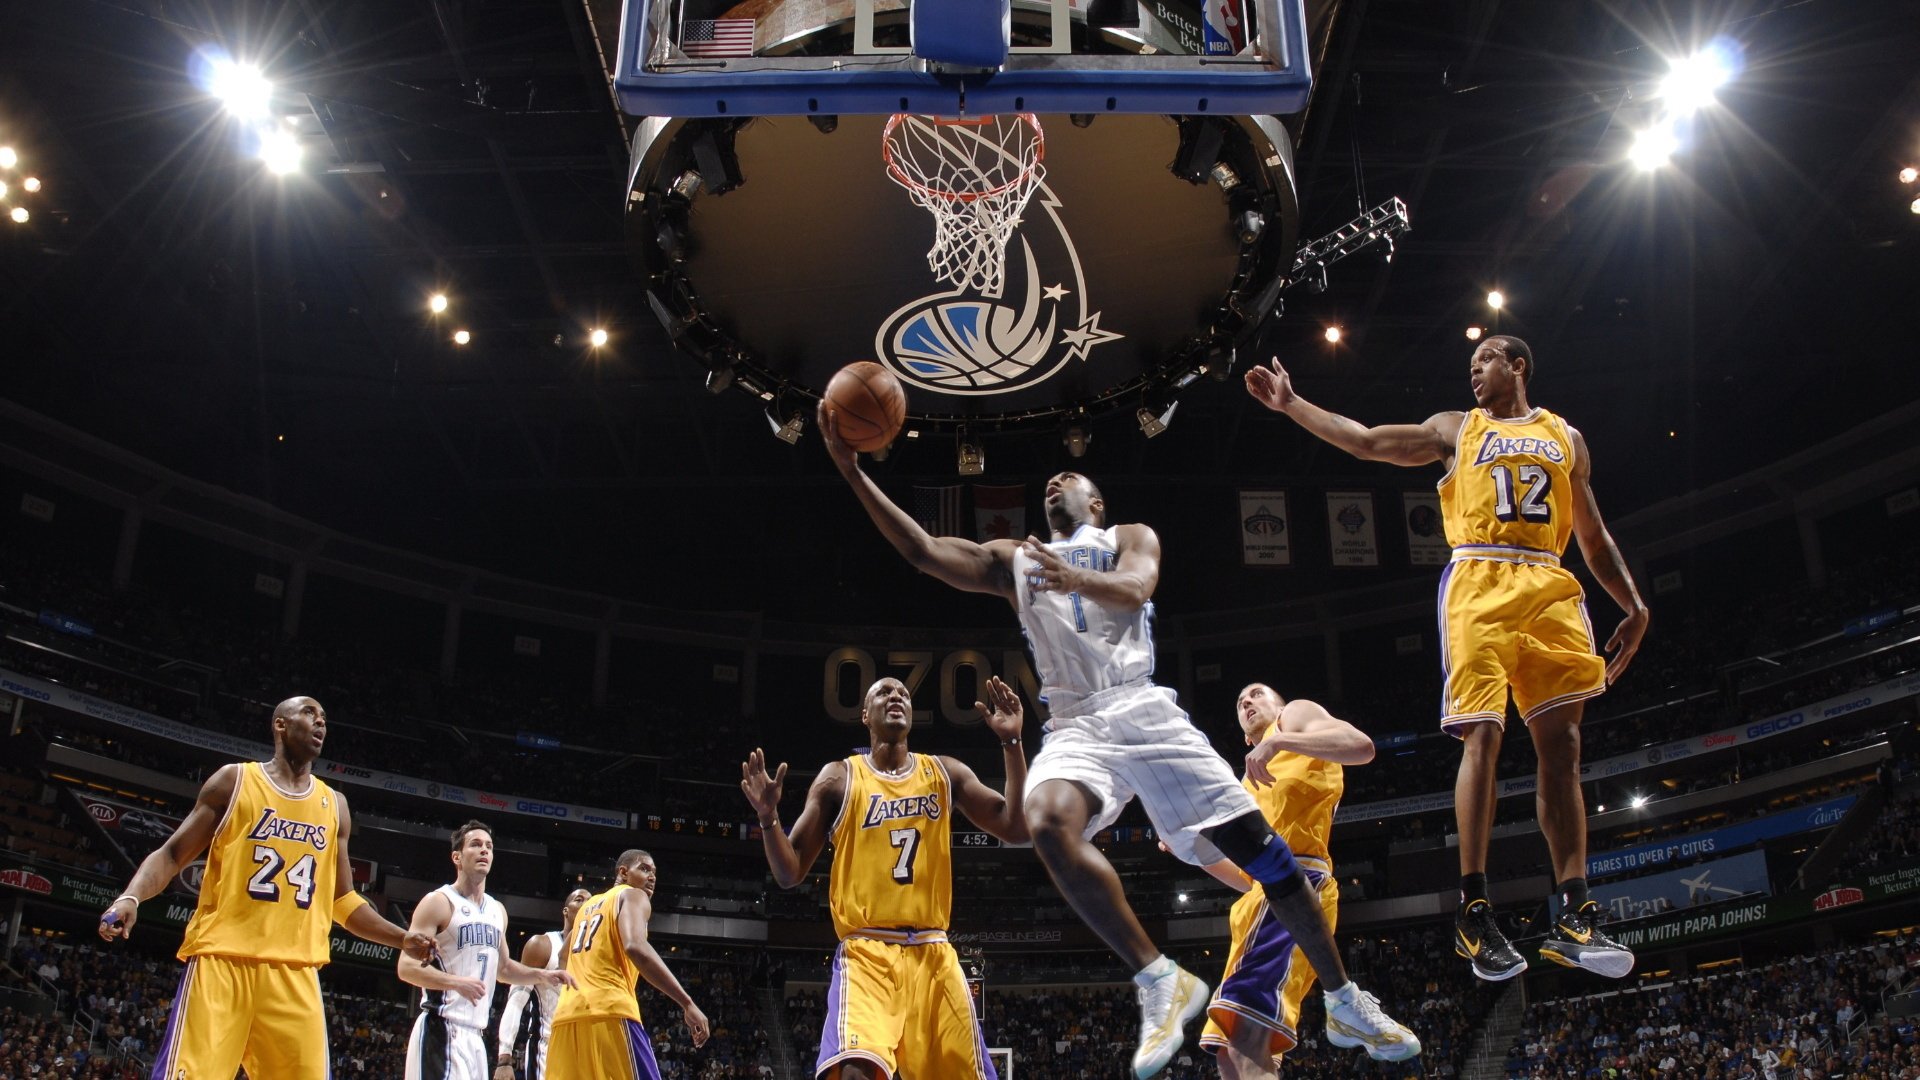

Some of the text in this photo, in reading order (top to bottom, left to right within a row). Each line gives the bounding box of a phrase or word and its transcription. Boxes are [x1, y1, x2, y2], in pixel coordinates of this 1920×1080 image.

[1156, 2, 1199, 36] Better
[1209, 41, 1230, 52] NBA
[1473, 431, 1564, 467] LAKERS
[1491, 464, 1552, 524] 12
[1068, 592, 1087, 633] 1
[2, 680, 50, 701] PEPSICO
[1746, 697, 1872, 739] GEICO PEPSICO
[1705, 733, 1737, 748] Disney
[326, 763, 372, 779] HARRIS
[478, 792, 509, 810] Disney
[517, 801, 567, 818] GEICO
[92, 807, 111, 820] KIA
[861, 793, 940, 829] LAKERS
[247, 807, 327, 852] LAKERS
[584, 815, 622, 827] PEPSICO
[722, 827, 728, 836] 2
[963, 835, 988, 846] 4:52
[1114, 830, 1120, 842] 1
[1146, 828, 1152, 840] 4
[890, 828, 921, 884] 7
[1592, 857, 1622, 874] FARES
[1624, 855, 1636, 868] TO
[1640, 848, 1664, 864] OVER
[1681, 838, 1715, 856] CITIES
[61, 875, 88, 893] Better
[247, 844, 317, 910] 24
[1868, 872, 1896, 887] Better
[73, 889, 98, 905] Better
[1884, 881, 1914, 894] Better
[572, 913, 603, 954] 17
[1618, 904, 1767, 946] WIN WITH PAPA JOHNS!
[457, 922, 500, 950] MAGI
[980, 931, 1034, 941] BASELINE
[1036, 931, 1061, 941] BAR
[348, 940, 393, 960] JOHNS!
[477, 953, 488, 981] 7
